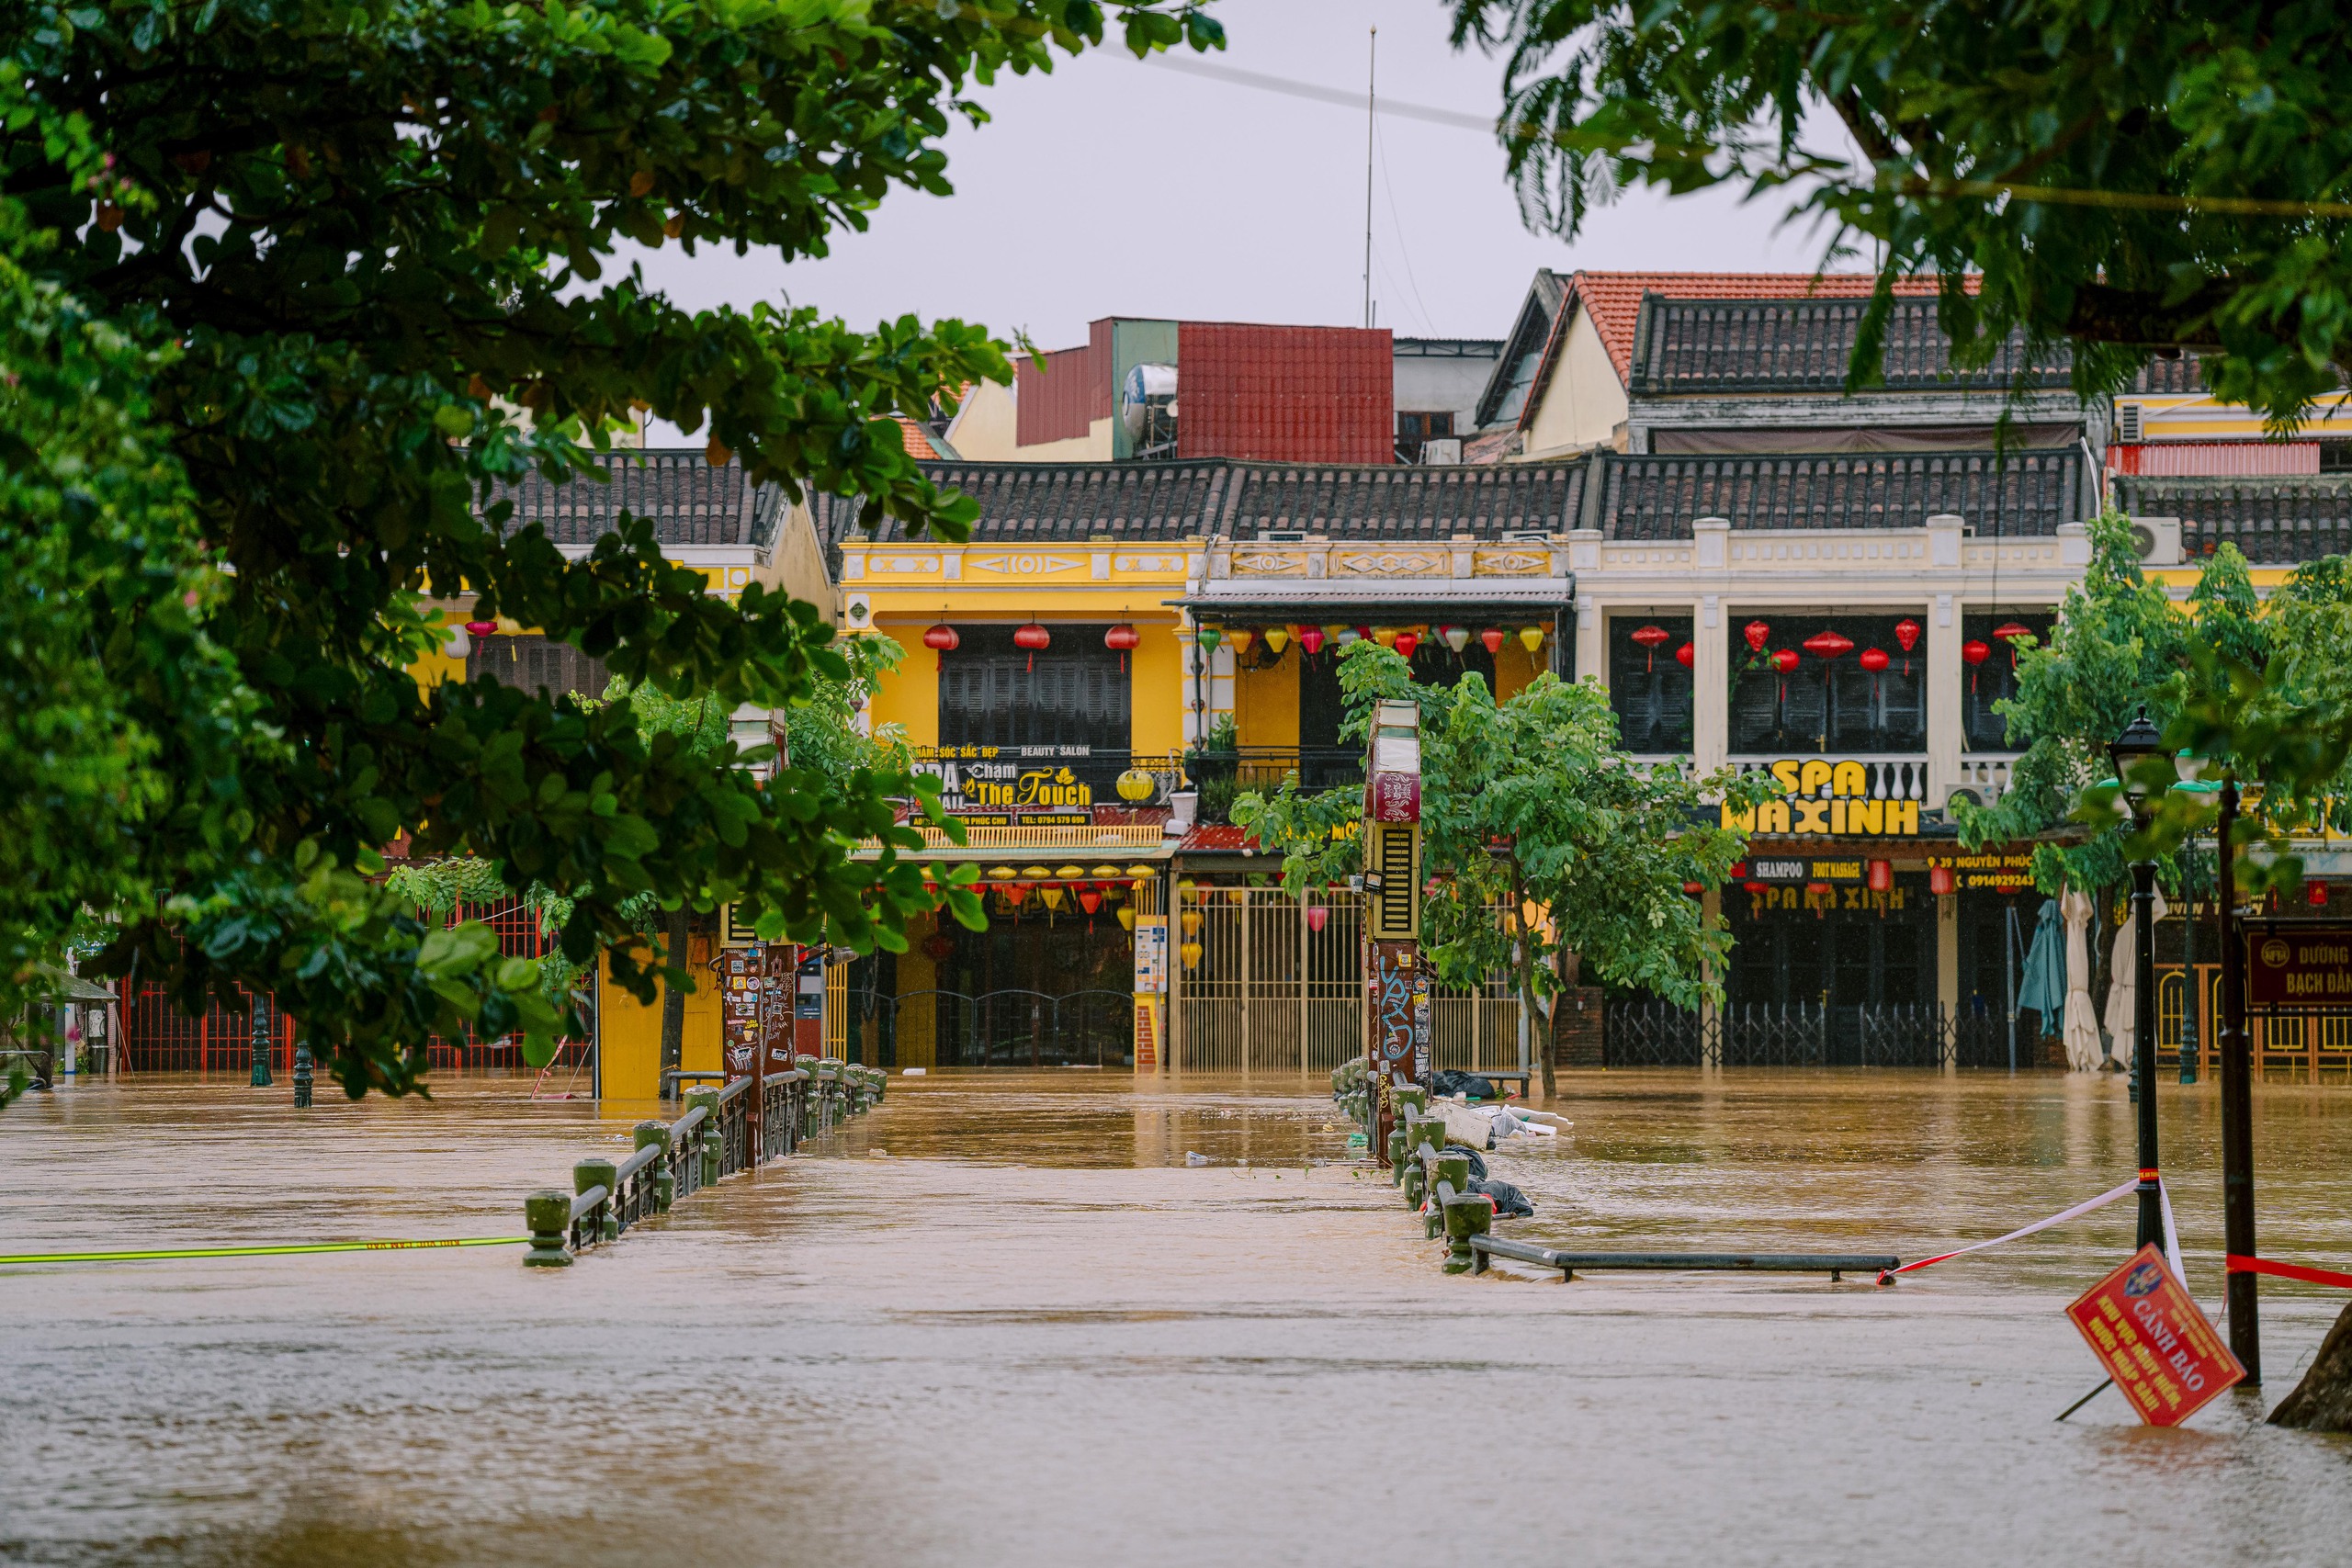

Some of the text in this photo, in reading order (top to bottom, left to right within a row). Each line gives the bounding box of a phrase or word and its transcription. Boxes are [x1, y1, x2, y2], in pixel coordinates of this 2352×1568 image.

[981, 747, 999, 760] ĐẸP
[1021, 745, 1090, 756] BEAUTY SALON
[966, 762, 1016, 781] Chạm
[1771, 759, 1867, 796] SPA
[977, 766, 1091, 807] The Touch
[936, 795, 967, 810] AIL
[991, 816, 1007, 825] CHU
[1022, 816, 1036, 825] TEL:
[1756, 862, 1804, 878] SHAMPOO
[1940, 857, 1952, 868] 39
[2286, 972, 2324, 997] BẠCH
